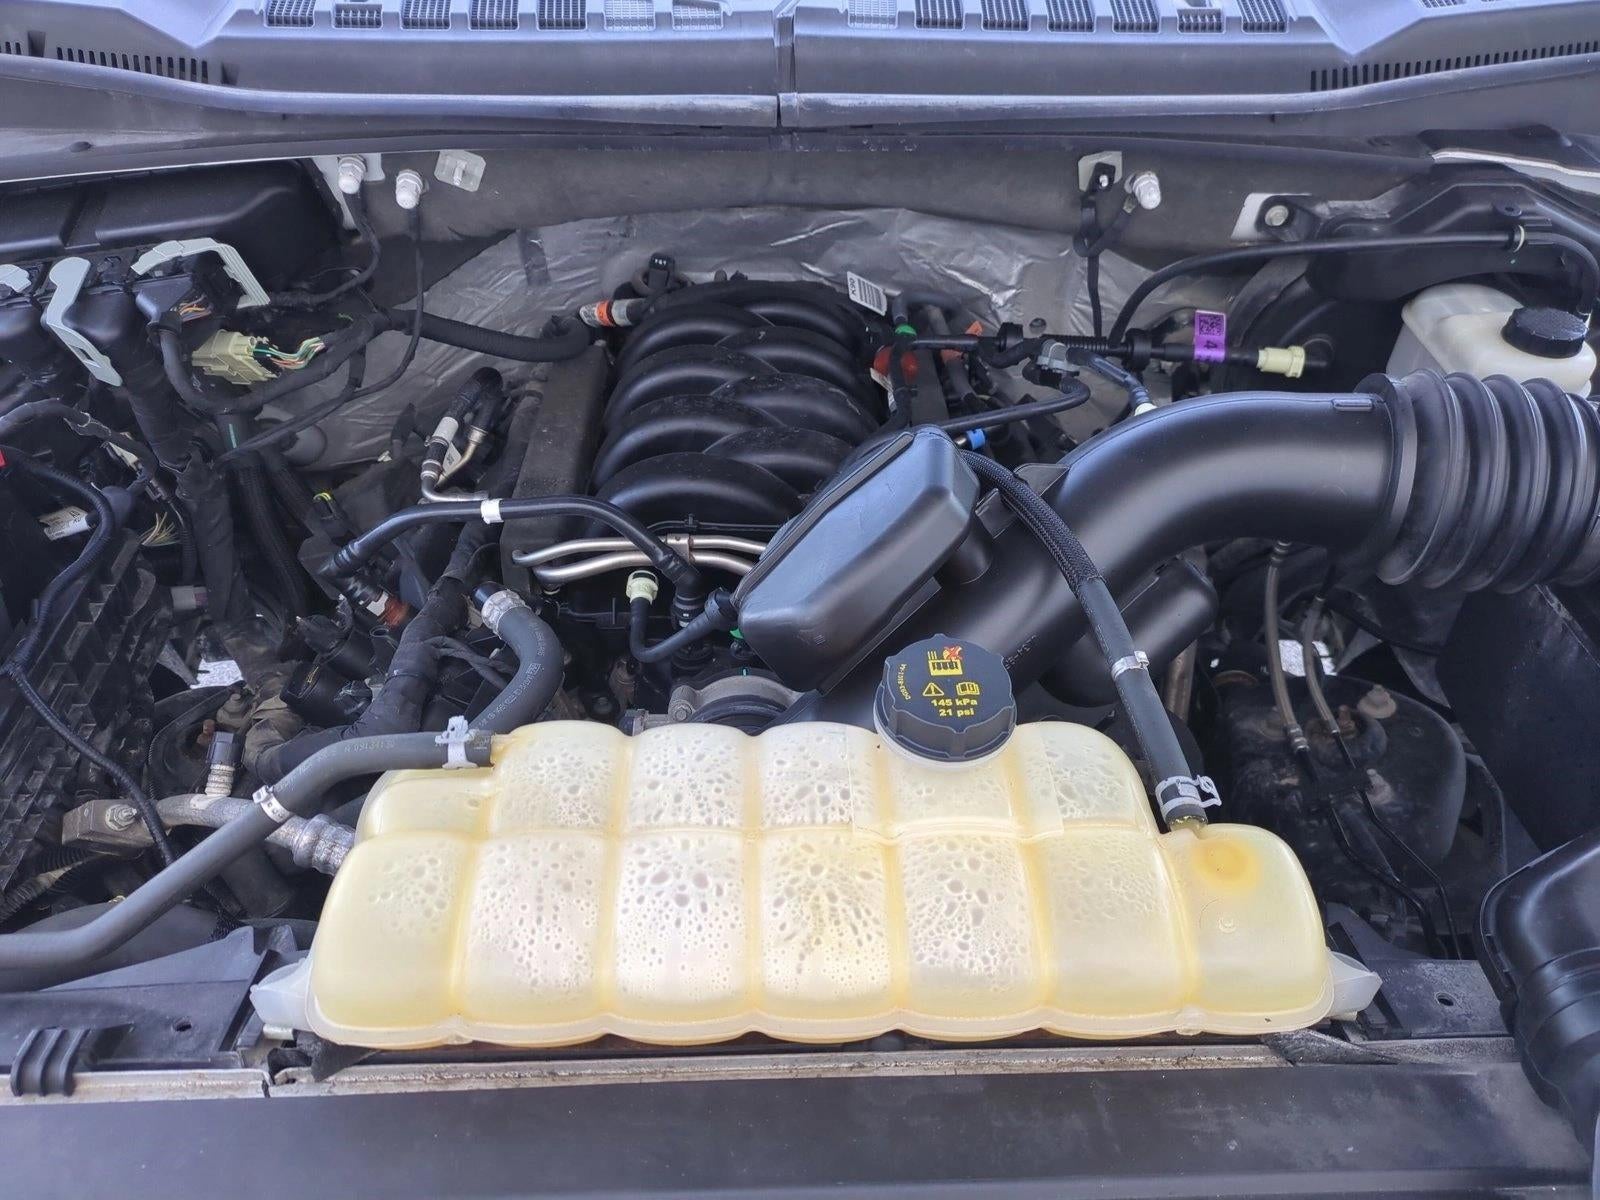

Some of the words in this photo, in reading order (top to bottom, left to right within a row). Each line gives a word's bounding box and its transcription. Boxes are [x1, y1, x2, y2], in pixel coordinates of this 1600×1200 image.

[931, 698, 953, 707] 145
[955, 698, 978, 707] kPa
[939, 709, 953, 717] 21
[957, 708, 975, 718] psi
